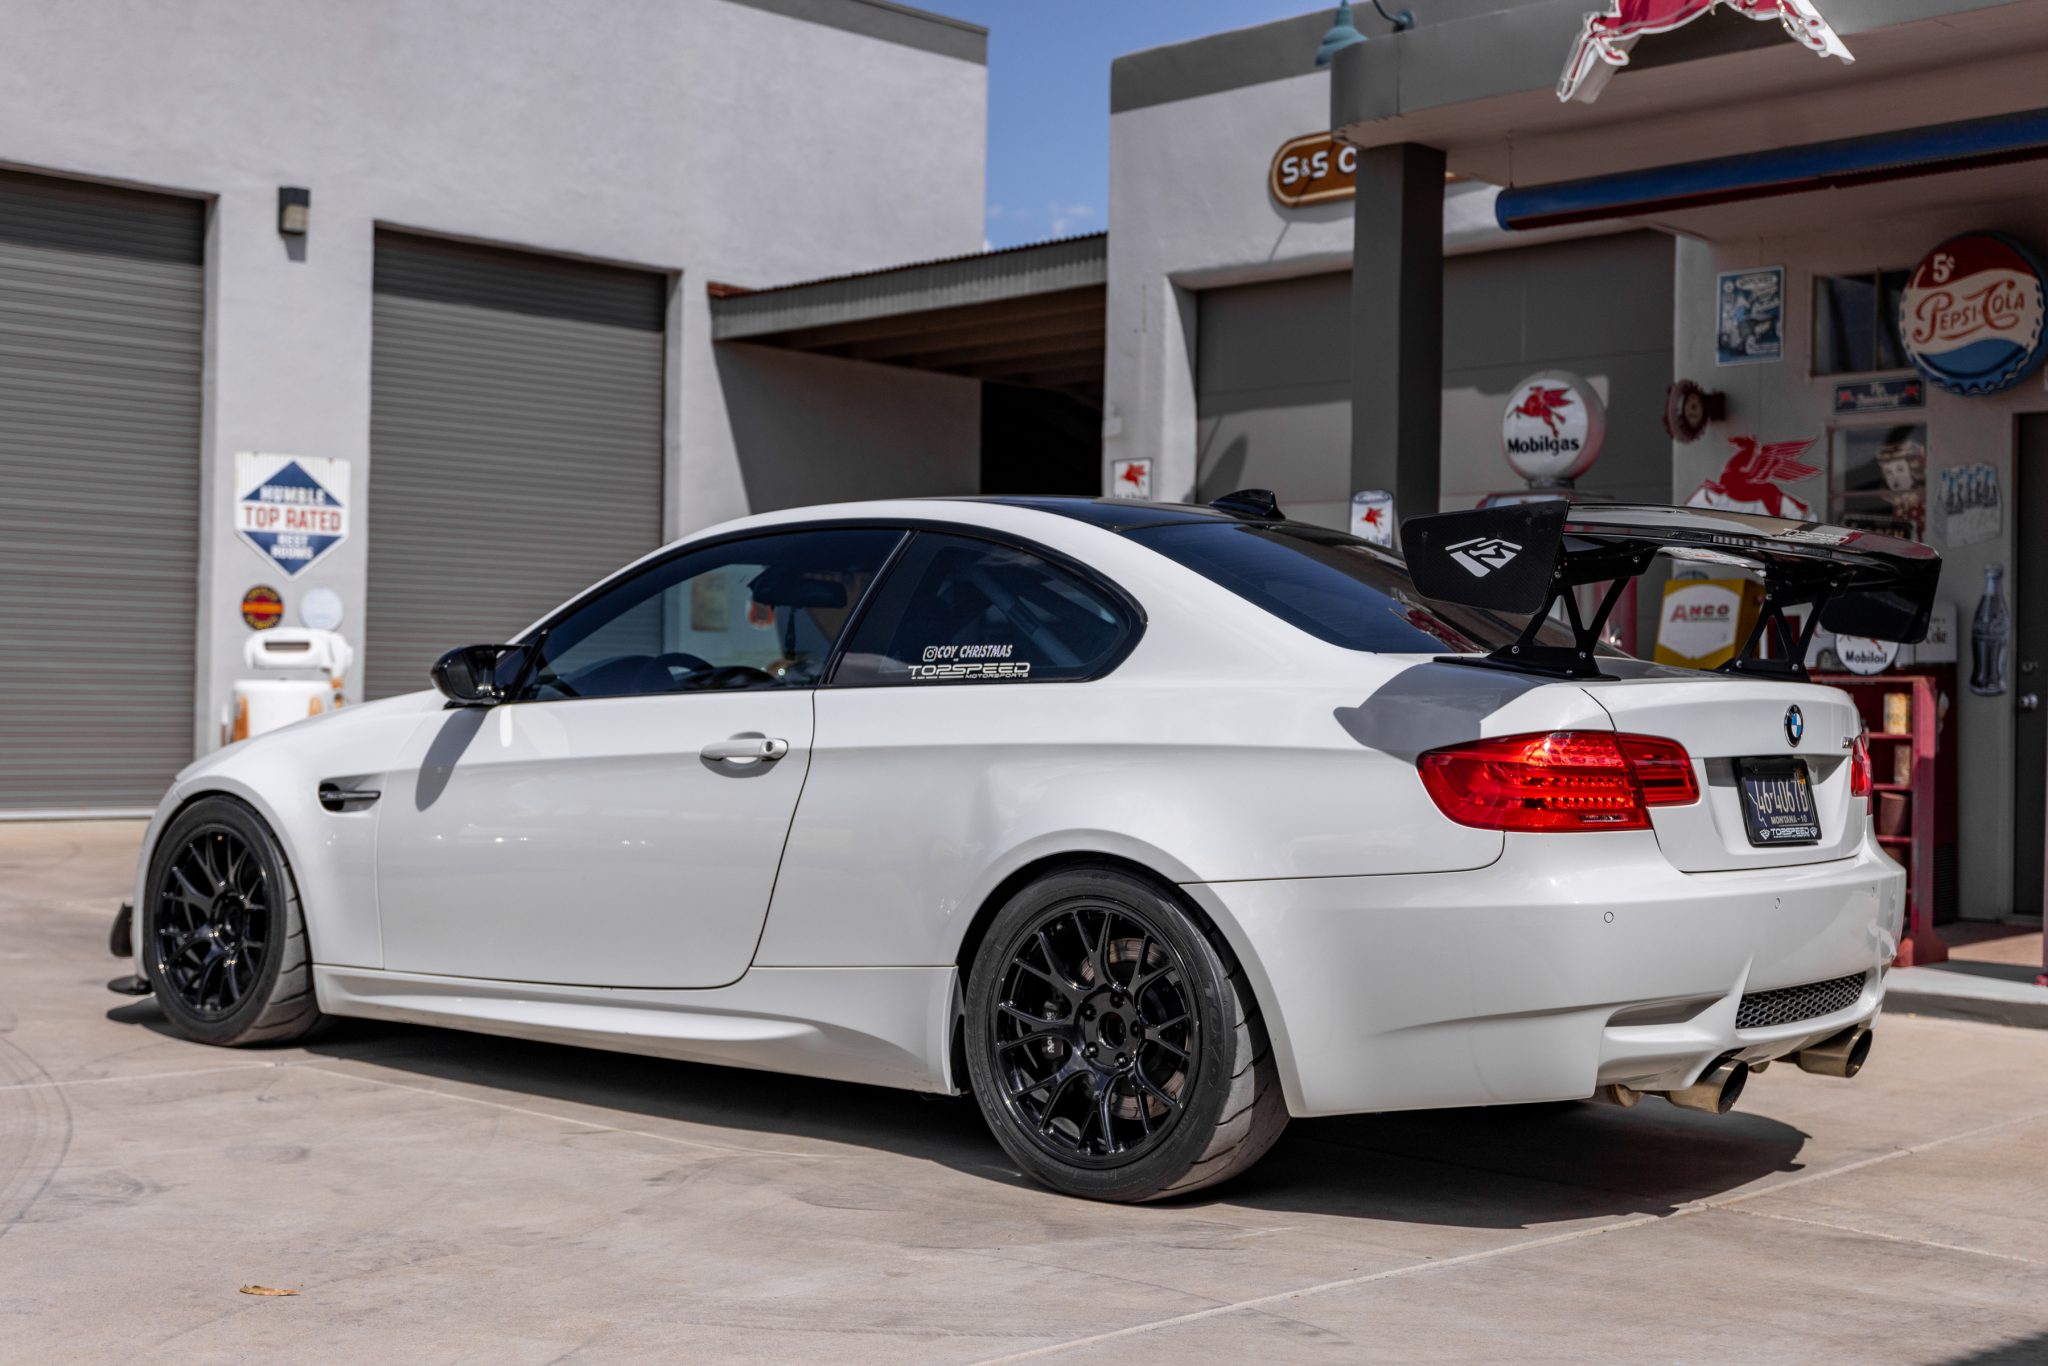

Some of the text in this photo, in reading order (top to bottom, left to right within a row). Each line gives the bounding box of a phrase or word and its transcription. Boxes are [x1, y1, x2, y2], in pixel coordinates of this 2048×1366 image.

[1282, 151, 1328, 185] S&S
[1507, 435, 1580, 456] Mobilgas
[245, 505, 341, 532] TOP RATED
[1845, 650, 1888, 664] Mobiloil
[908, 662, 1031, 676] TOPSPEED
[1770, 815, 1797, 825] MONTANA
[1770, 827, 1810, 836] TOPSPEED
